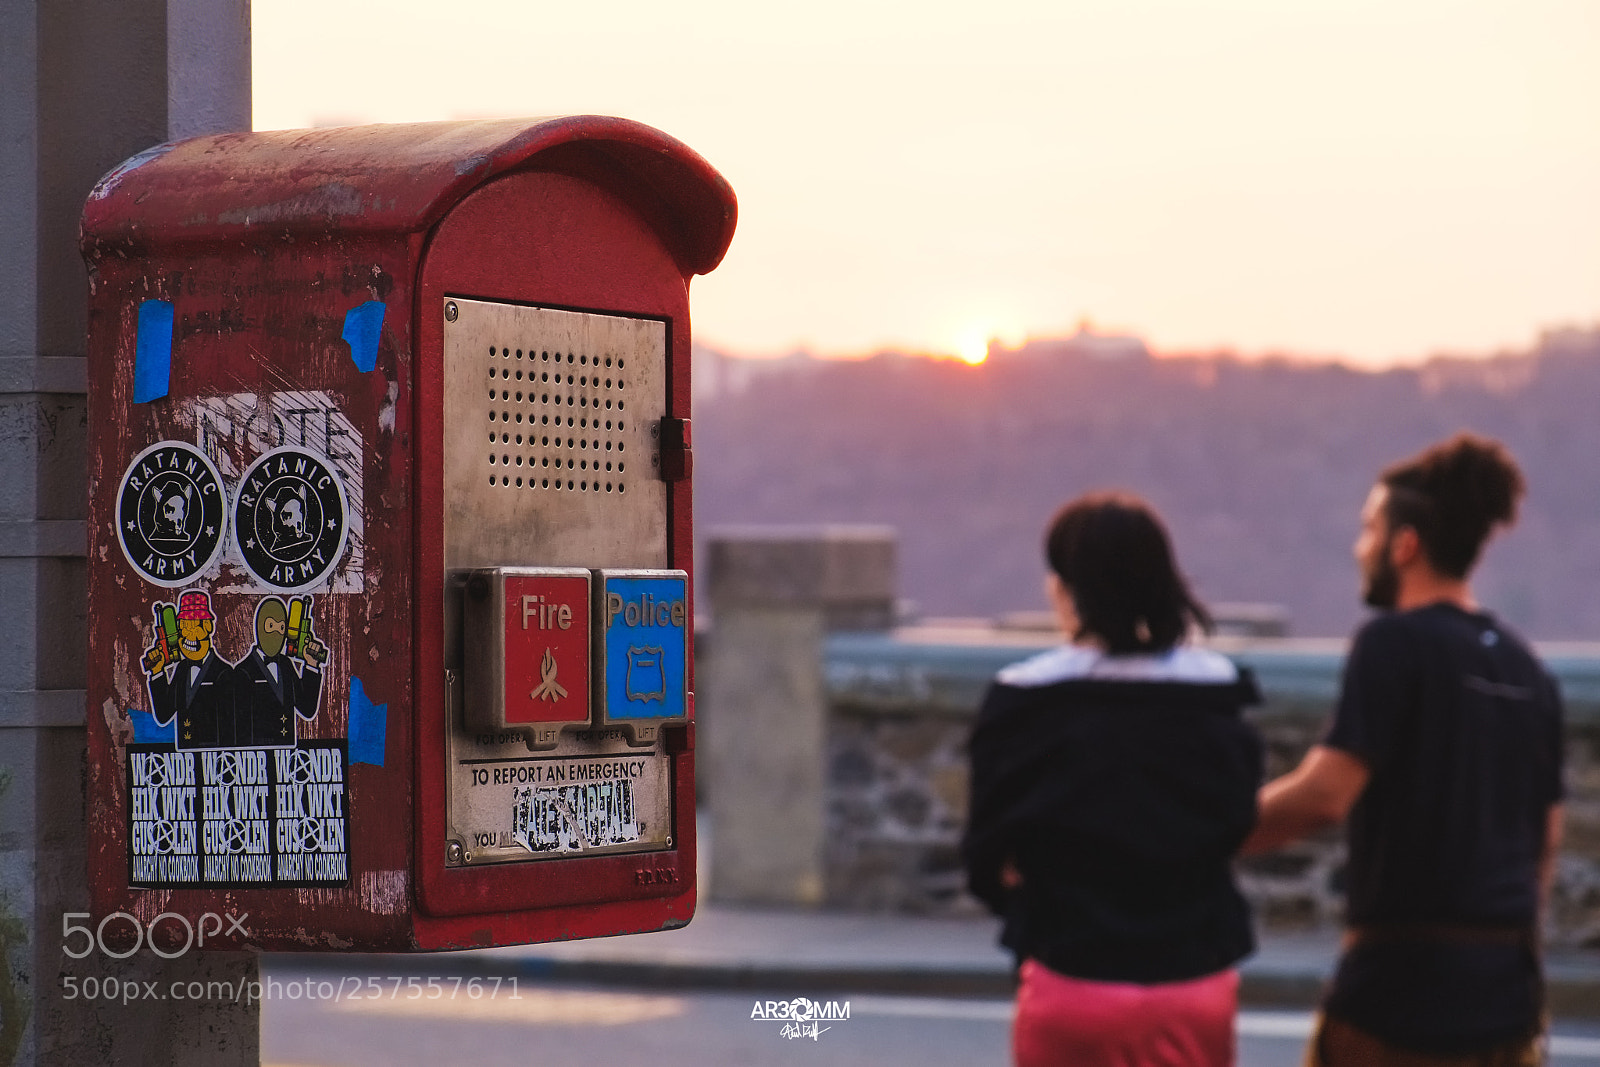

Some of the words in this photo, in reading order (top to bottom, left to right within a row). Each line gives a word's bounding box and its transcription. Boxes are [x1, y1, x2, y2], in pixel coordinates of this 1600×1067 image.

[129, 451, 217, 497] RATANIC
[241, 457, 331, 508] RATANIC
[142, 549, 198, 576] ARMY
[269, 547, 326, 584] ARMY
[522, 595, 573, 630] Fire
[606, 591, 685, 628] Police
[539, 730, 557, 742] LIFT
[638, 727, 655, 739] LIFT
[472, 768, 489, 786] TO
[493, 766, 543, 784] REPORT
[547, 764, 565, 781] AN
[569, 761, 645, 781] EMERGENCY
[161, 787, 197, 821] WKT
[233, 786, 269, 819] WKT
[307, 784, 344, 818] WKT
[474, 831, 496, 848] YOU
[158, 855, 168, 881] NO
[230, 855, 240, 881] NO
[304, 854, 314, 881] NO
